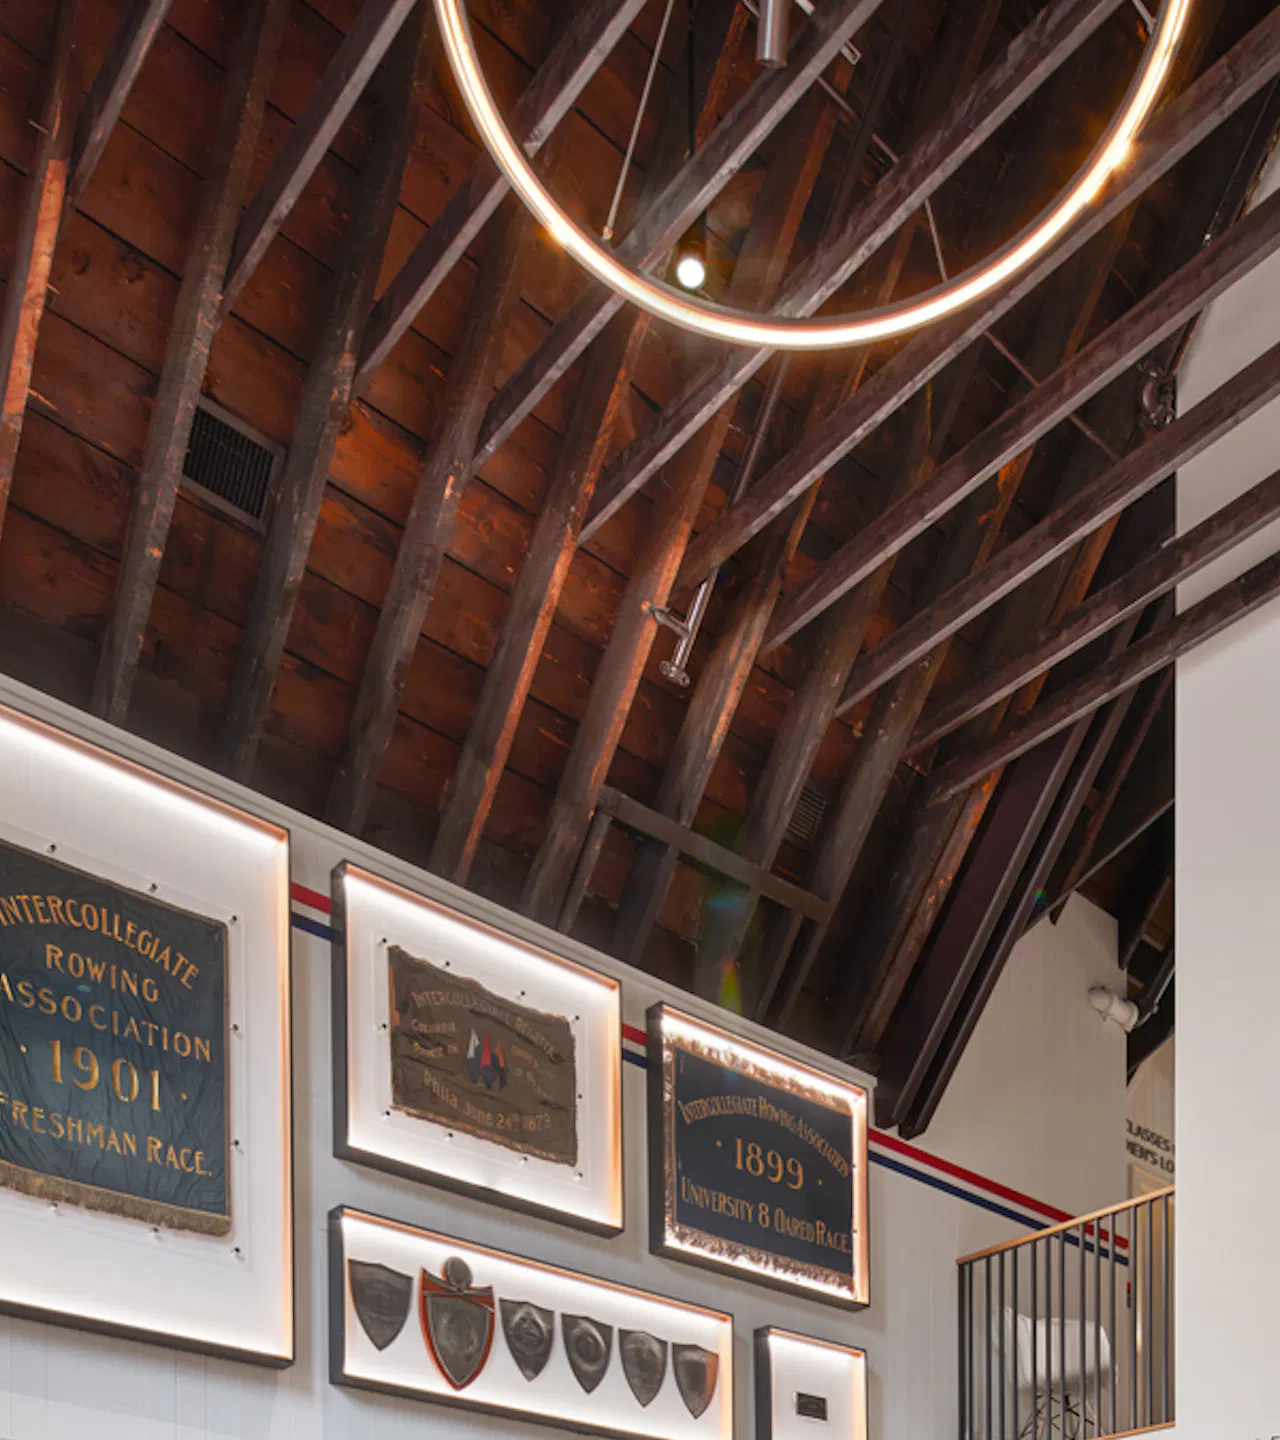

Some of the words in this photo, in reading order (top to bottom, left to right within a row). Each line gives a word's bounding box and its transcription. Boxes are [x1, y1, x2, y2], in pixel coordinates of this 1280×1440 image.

[46, 944, 159, 1003] ROWING
[49, 1040, 160, 1111] 1901
[147, 1136, 213, 1177] RACE.
[678, 1095, 759, 1125] INTERCOLLEGIATE
[759, 1096, 797, 1133] ROWING
[796, 1116, 849, 1178] ASSOCIATION
[735, 1138, 804, 1190] 1899
[681, 1175, 755, 1224] UNIVERSITY
[774, 1207, 815, 1243] OARED
